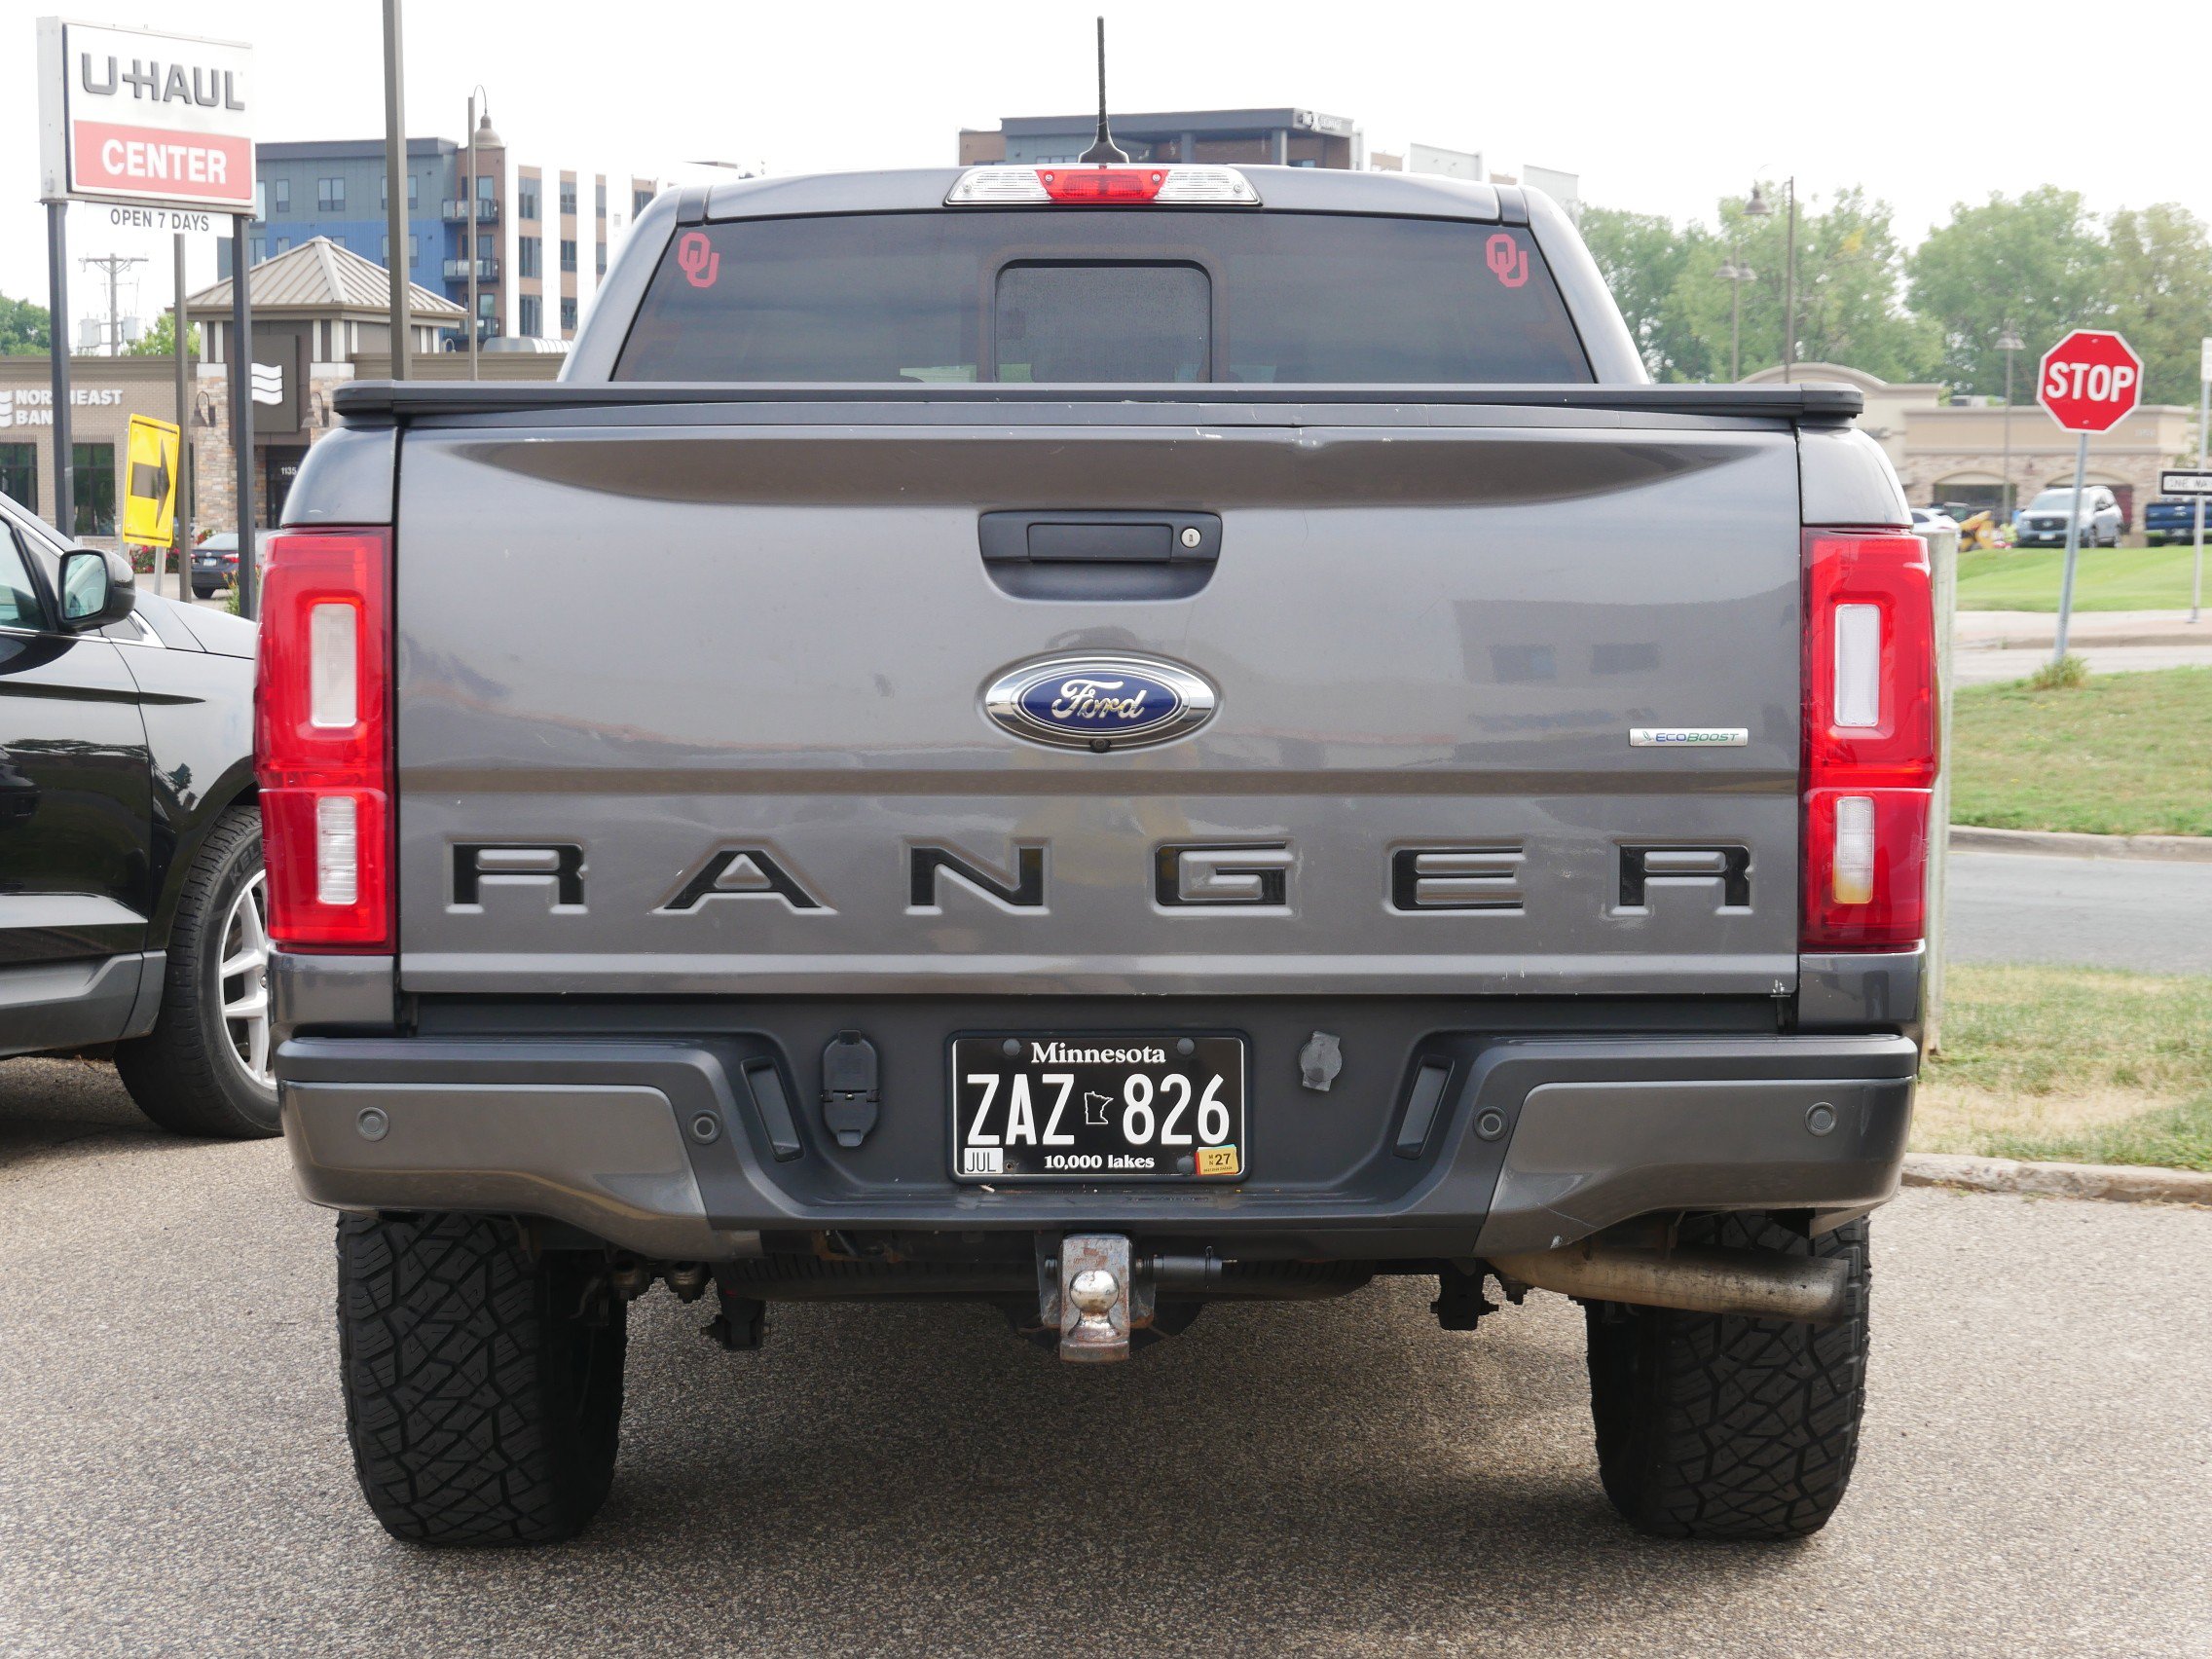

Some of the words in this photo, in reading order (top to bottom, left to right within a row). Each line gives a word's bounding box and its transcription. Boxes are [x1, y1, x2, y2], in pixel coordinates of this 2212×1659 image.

[101, 138, 228, 184] CENTER
[110, 207, 152, 228] OPEN
[158, 213, 166, 229] 7
[171, 214, 209, 231] DAYS
[2046, 361, 2135, 403] STOP
[16, 389, 123, 405] NOREAST
[16, 409, 55, 424] BAN
[1051, 679, 1148, 719] Ford
[447, 839, 1752, 914] RANGER
[1030, 1042, 1166, 1064] Minnesota
[967, 1073, 1075, 1146] ZAZ
[1123, 1073, 1230, 1145] 826
[966, 1152, 997, 1172] JUL
[1044, 1155, 1103, 1170] 10,000
[1108, 1155, 1155, 1168] lakes
[1214, 1153, 1231, 1166] 27
